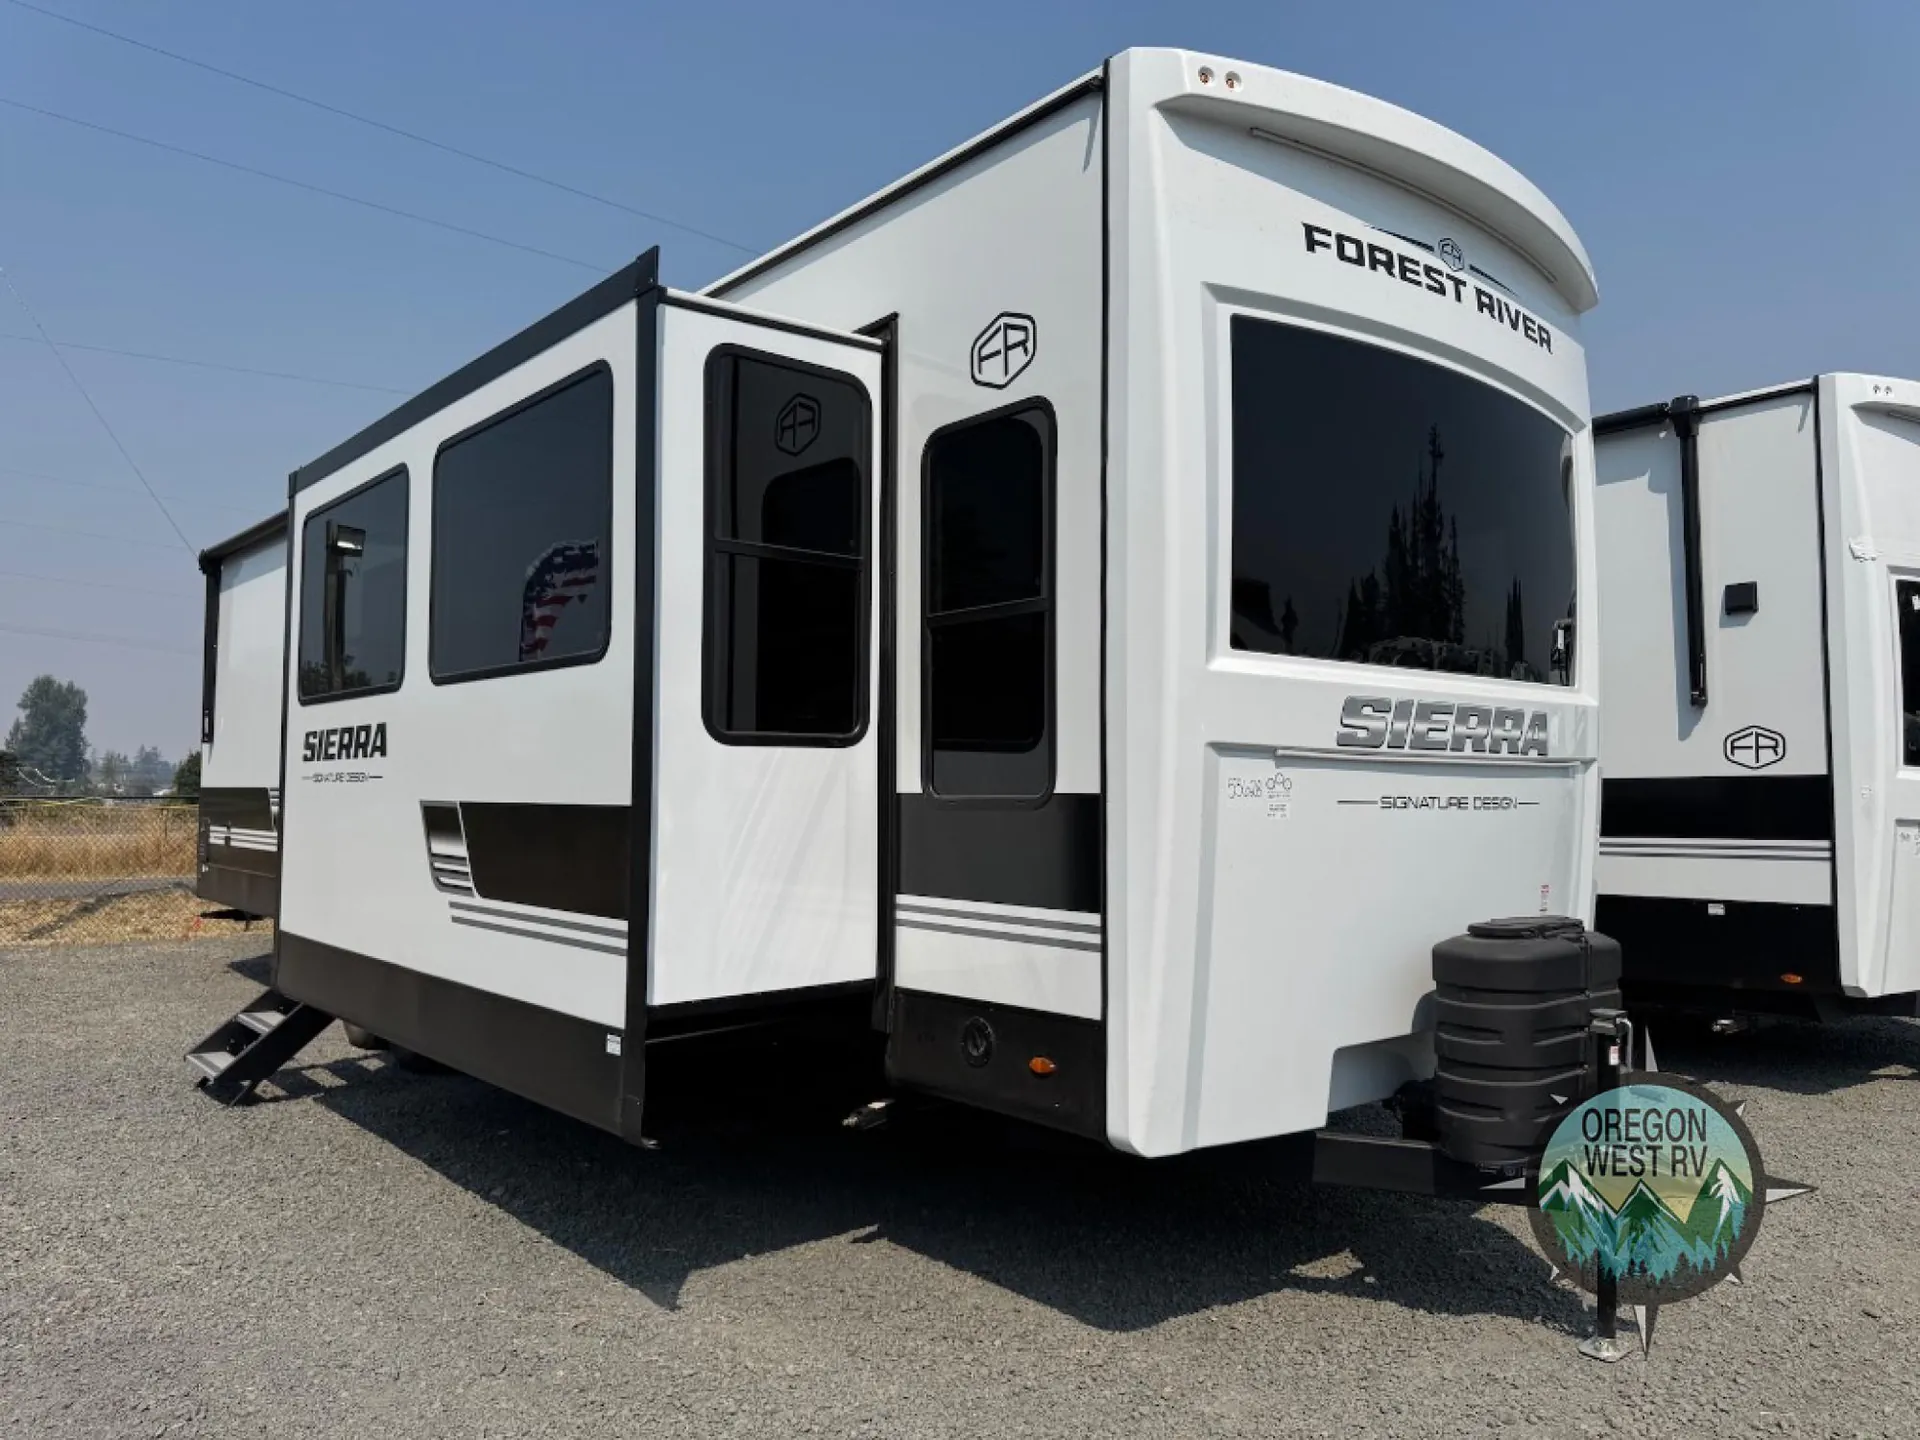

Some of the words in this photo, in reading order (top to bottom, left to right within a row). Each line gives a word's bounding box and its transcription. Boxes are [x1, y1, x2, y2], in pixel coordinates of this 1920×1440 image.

[1302, 222, 1467, 304] FOREST
[1474, 285, 1553, 355] RIVER
[302, 722, 387, 762] SIERRA
[1336, 695, 1549, 756] SIERRA
[1379, 796, 1469, 810] SIGNATURE
[1473, 797, 1518, 810] DESIGN
